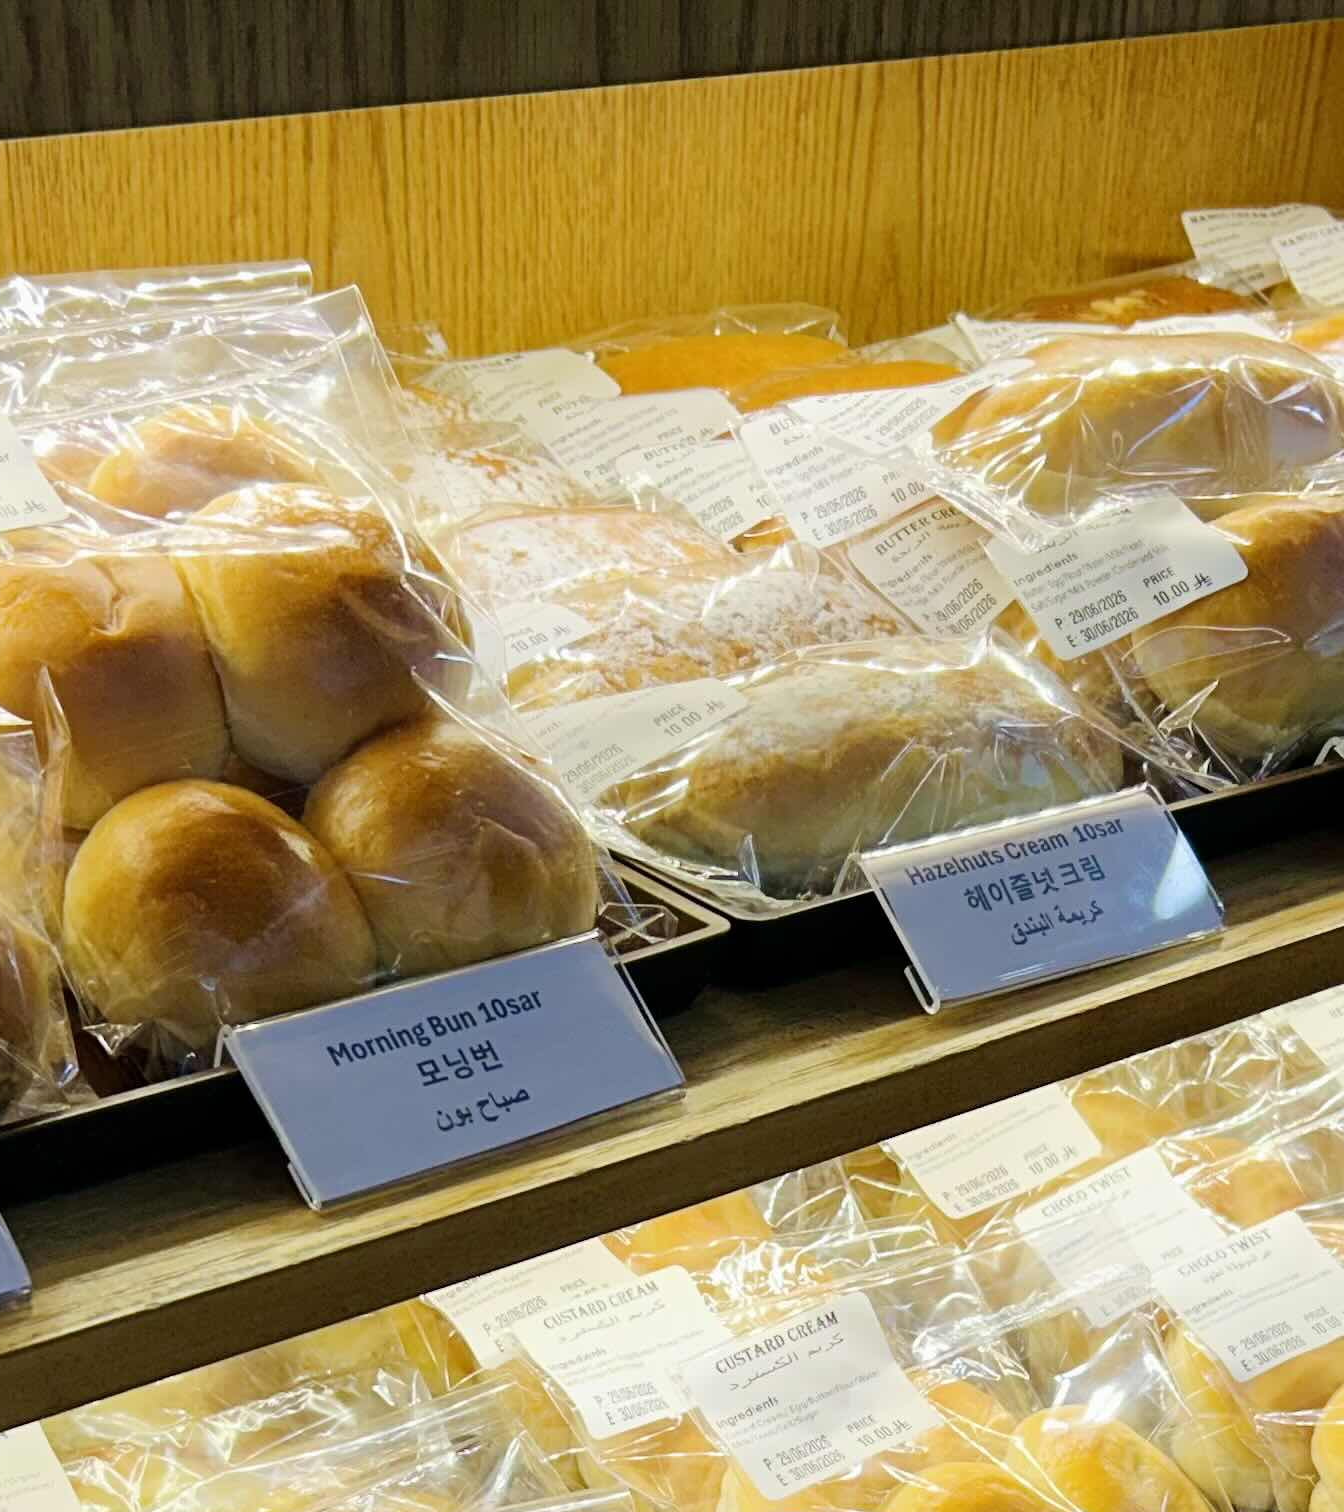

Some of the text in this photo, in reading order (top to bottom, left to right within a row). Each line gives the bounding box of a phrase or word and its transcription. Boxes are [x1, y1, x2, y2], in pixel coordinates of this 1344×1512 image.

[875, 518, 931, 556] BUTTER
[1142, 567, 1175, 588] PRICE
[1153, 580, 1190, 607] 10.00
[1069, 589, 1128, 625] 29/06/2026
[1081, 607, 1139, 644] 30/06/2026
[905, 816, 1125, 887] Hazelnuts Cream 10sar
[963, 853, 1106, 912] 헤이즐넛 크림
[1055, 899, 1104, 924] كريمة
[327, 988, 543, 1067] Morning Bun 10sar
[416, 1040, 504, 1088] 모닝번
[435, 1086, 531, 1133] صباح بون
[543, 1281, 660, 1330] CUSTARD CREAM
[715, 1331, 786, 1375] CUSTARD
[786, 1311, 839, 1343] CREAM
